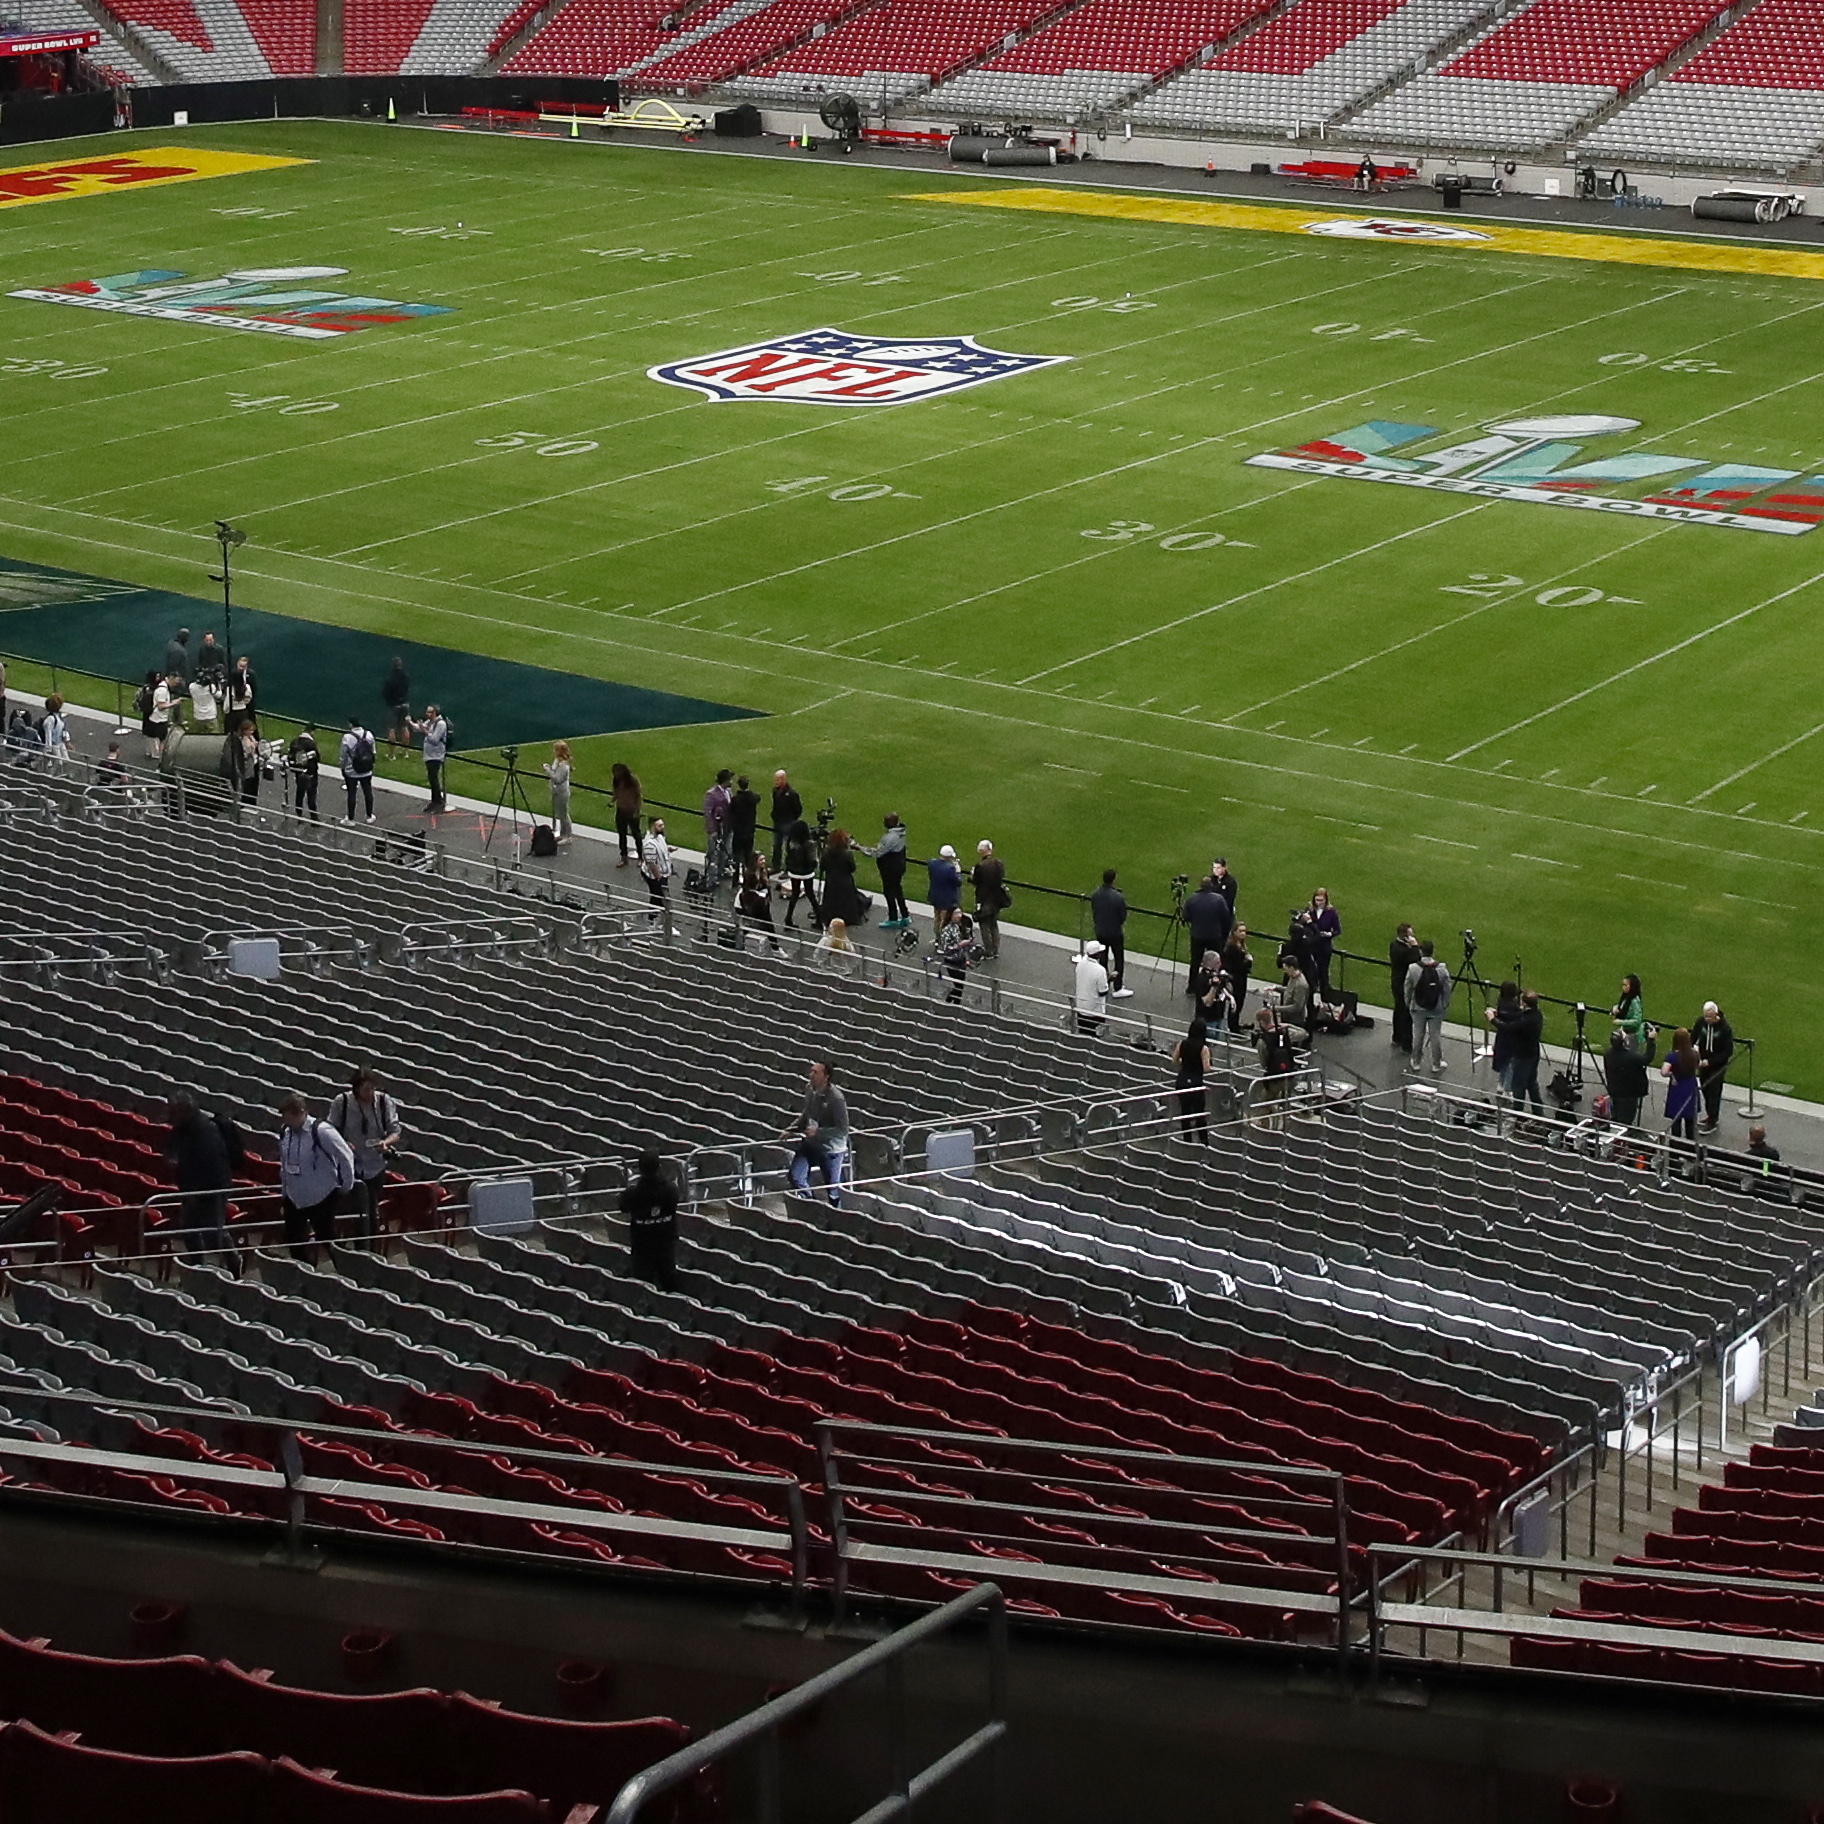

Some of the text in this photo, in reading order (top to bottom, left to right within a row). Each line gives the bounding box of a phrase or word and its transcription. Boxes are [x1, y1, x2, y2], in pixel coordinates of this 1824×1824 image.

[33, 292, 300, 335] SUPER BOWL
[697, 352, 921, 397] NFL
[230, 392, 340, 416] 40
[474, 431, 600, 457] 50
[764, 475, 894, 502] 40
[1291, 461, 1749, 527] SUPER BOWL
[1079, 519, 1227, 552] 30
[1440, 573, 1605, 608] 20
